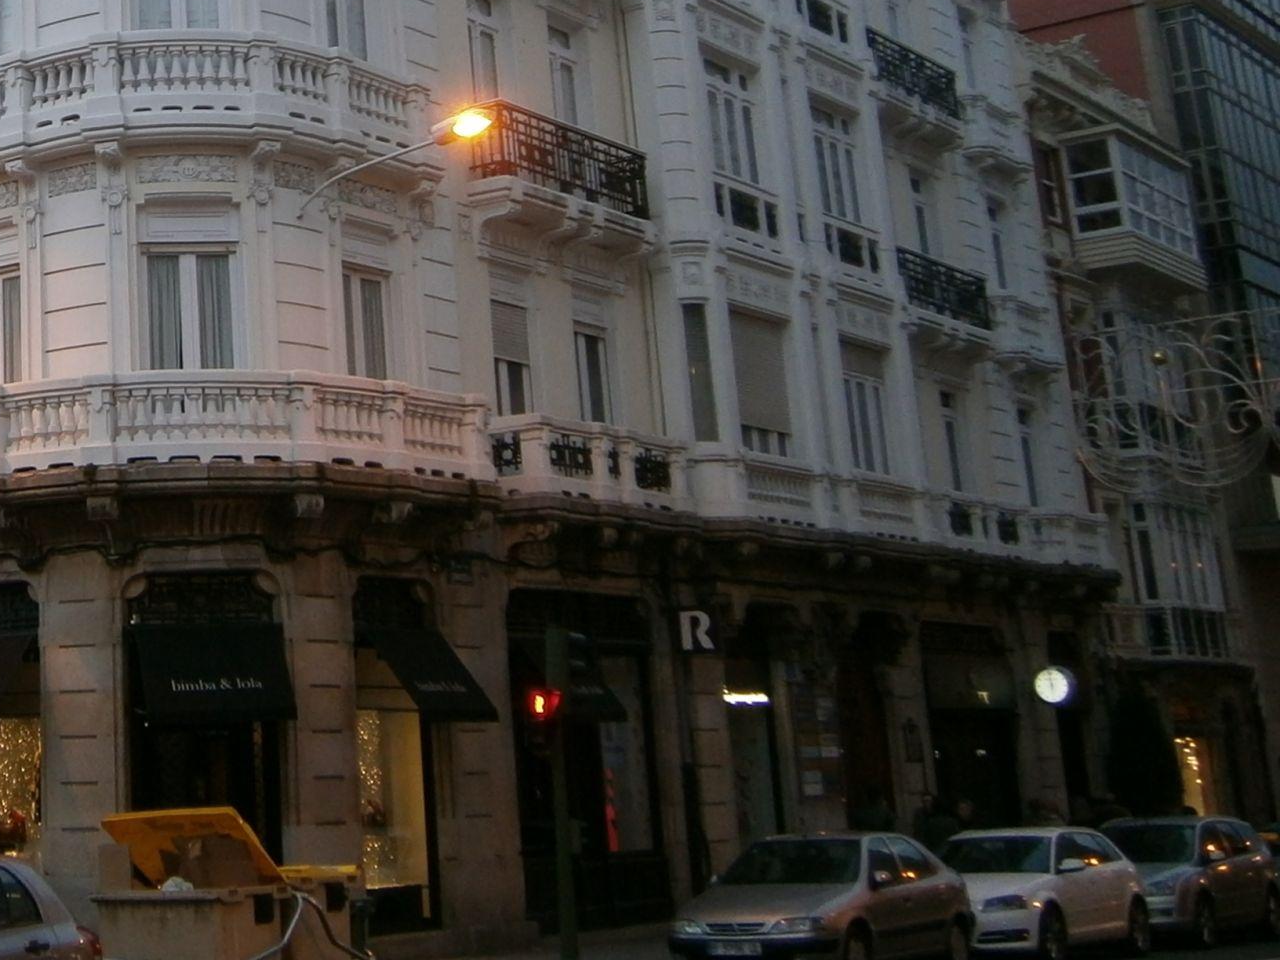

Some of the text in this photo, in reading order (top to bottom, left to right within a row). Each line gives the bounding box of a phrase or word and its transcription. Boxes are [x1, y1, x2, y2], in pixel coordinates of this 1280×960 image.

[678, 610, 716, 651] R
[170, 677, 263, 692] bimba & lola
